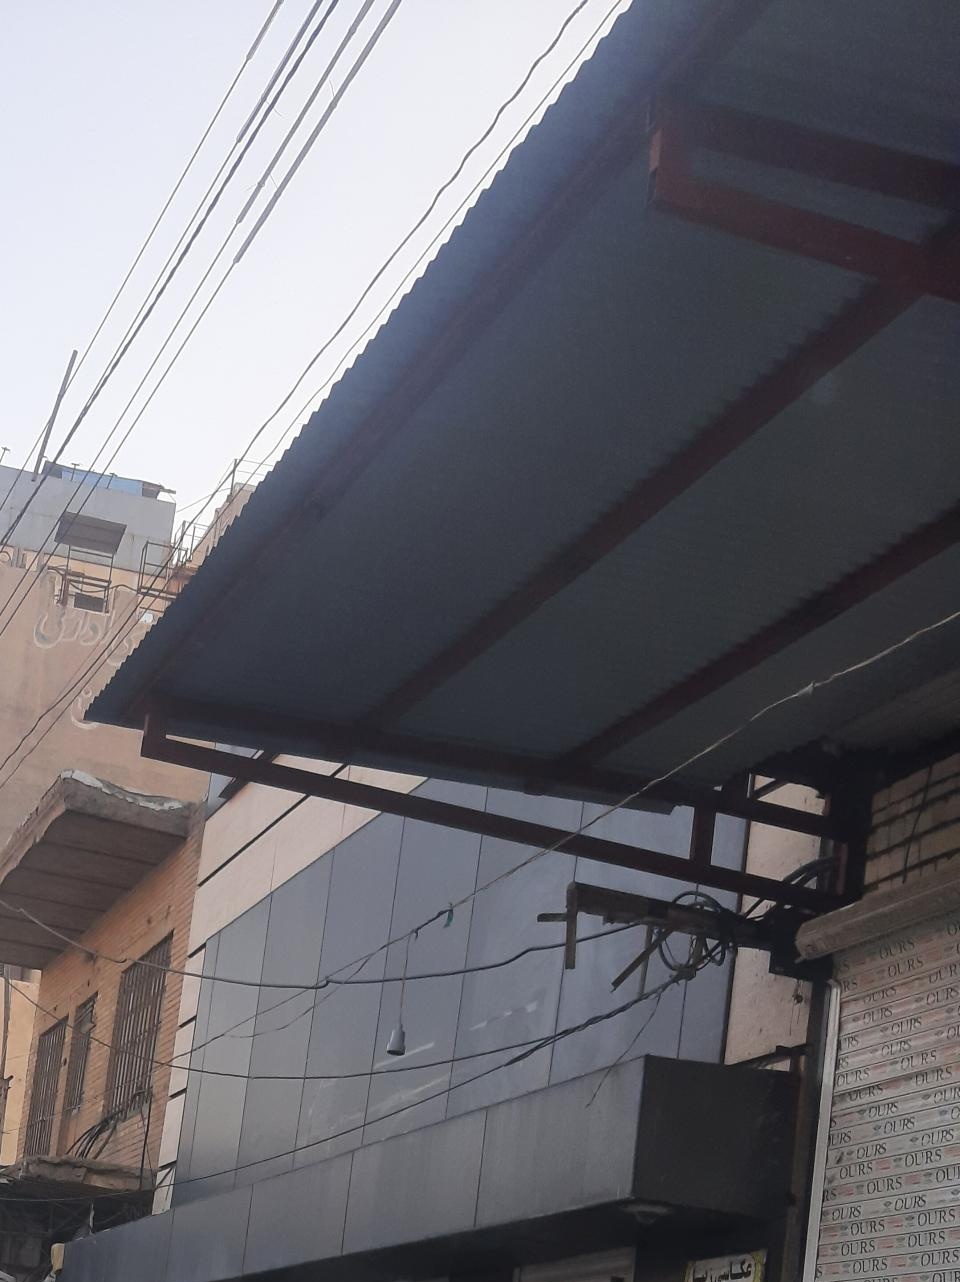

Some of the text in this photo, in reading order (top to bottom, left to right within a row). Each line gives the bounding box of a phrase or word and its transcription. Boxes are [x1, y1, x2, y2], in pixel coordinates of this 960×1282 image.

[888, 957, 923, 977] OURS
[929, 963, 960, 984] OUR
[863, 986, 959, 1024] OURS OURS
[891, 1016, 922, 1035] OURS
[881, 1039, 912, 1057] OURS
[836, 1049, 937, 1088] OURS OURS
[915, 1066, 953, 1087] OURS
[868, 1086, 960, 1118] OURS OUR
[829, 1117, 915, 1147] URS OURS
[856, 1128, 954, 1159] OURS OURS
[839, 1149, 942, 1180] OURS OURS
[866, 1176, 902, 1195] OURS
[832, 1194, 927, 1221] OURS OURS
[850, 1208, 955, 1237] OURS OURS
[841, 1230, 945, 1257] OURS OURS
[853, 1249, 960, 1274] OURS OURS
